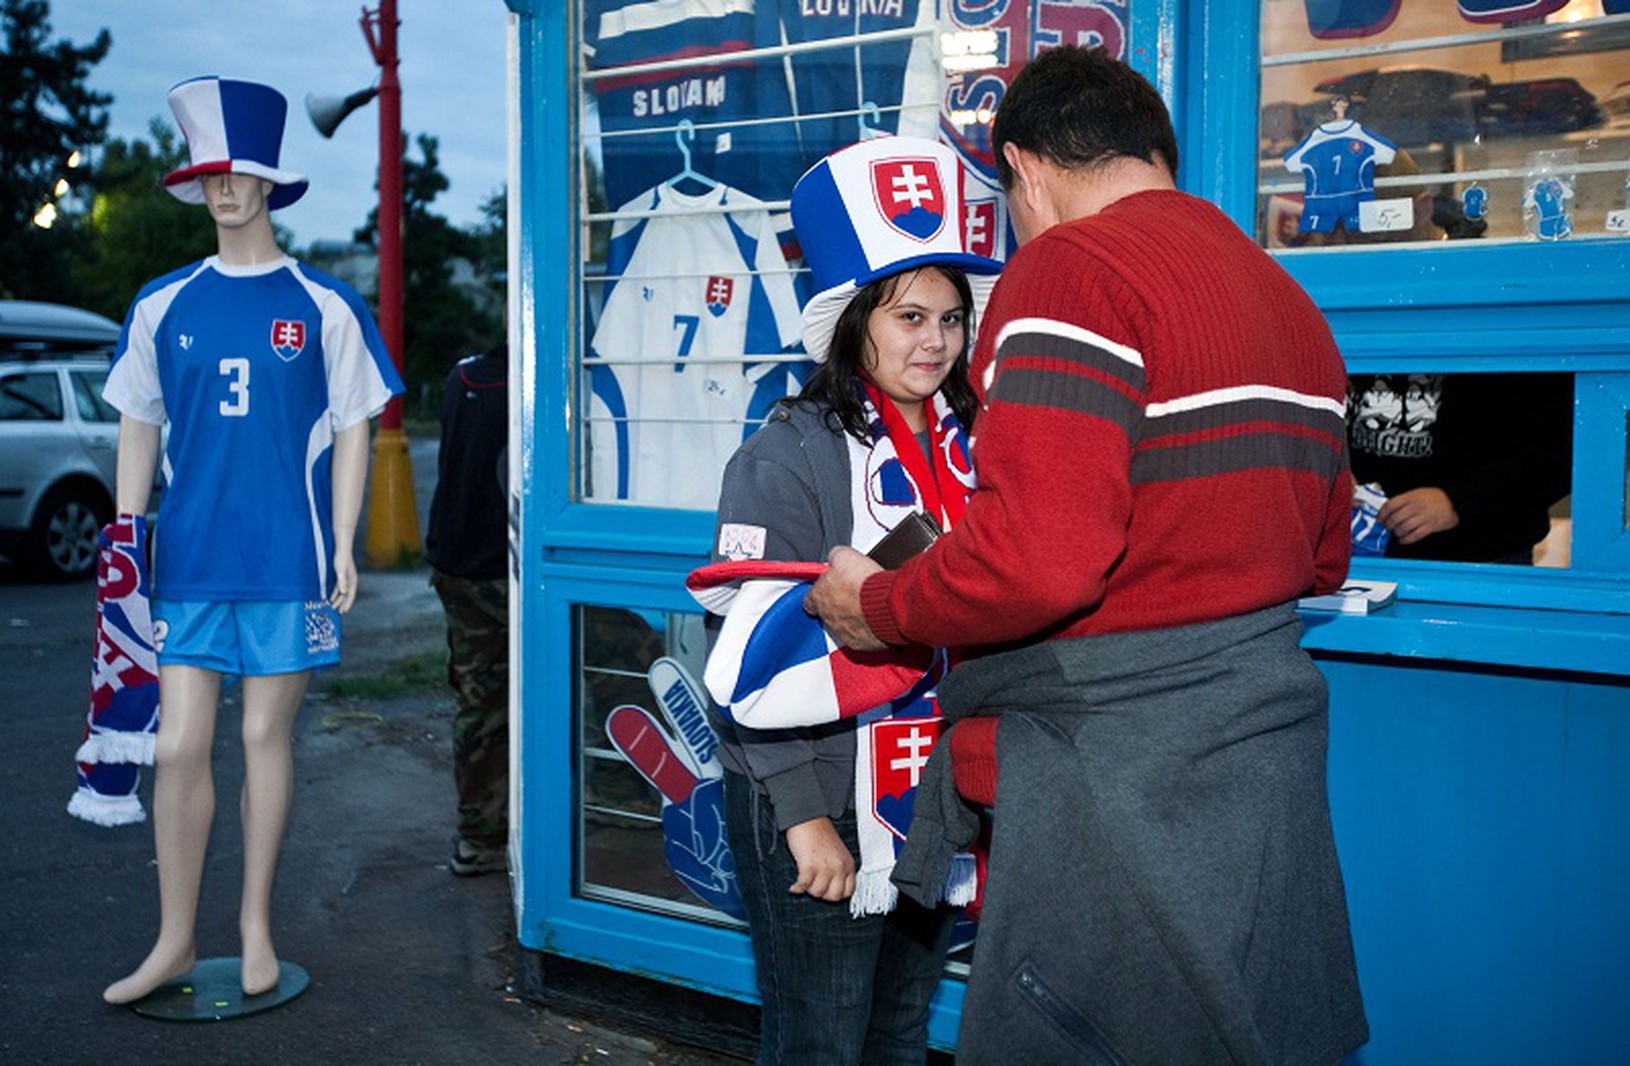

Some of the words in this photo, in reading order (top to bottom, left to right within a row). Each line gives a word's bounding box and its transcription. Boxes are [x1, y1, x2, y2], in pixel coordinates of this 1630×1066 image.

[673, 314, 700, 374] 7
[218, 357, 250, 417] 3
[662, 678, 719, 765] SLOVAKIA
